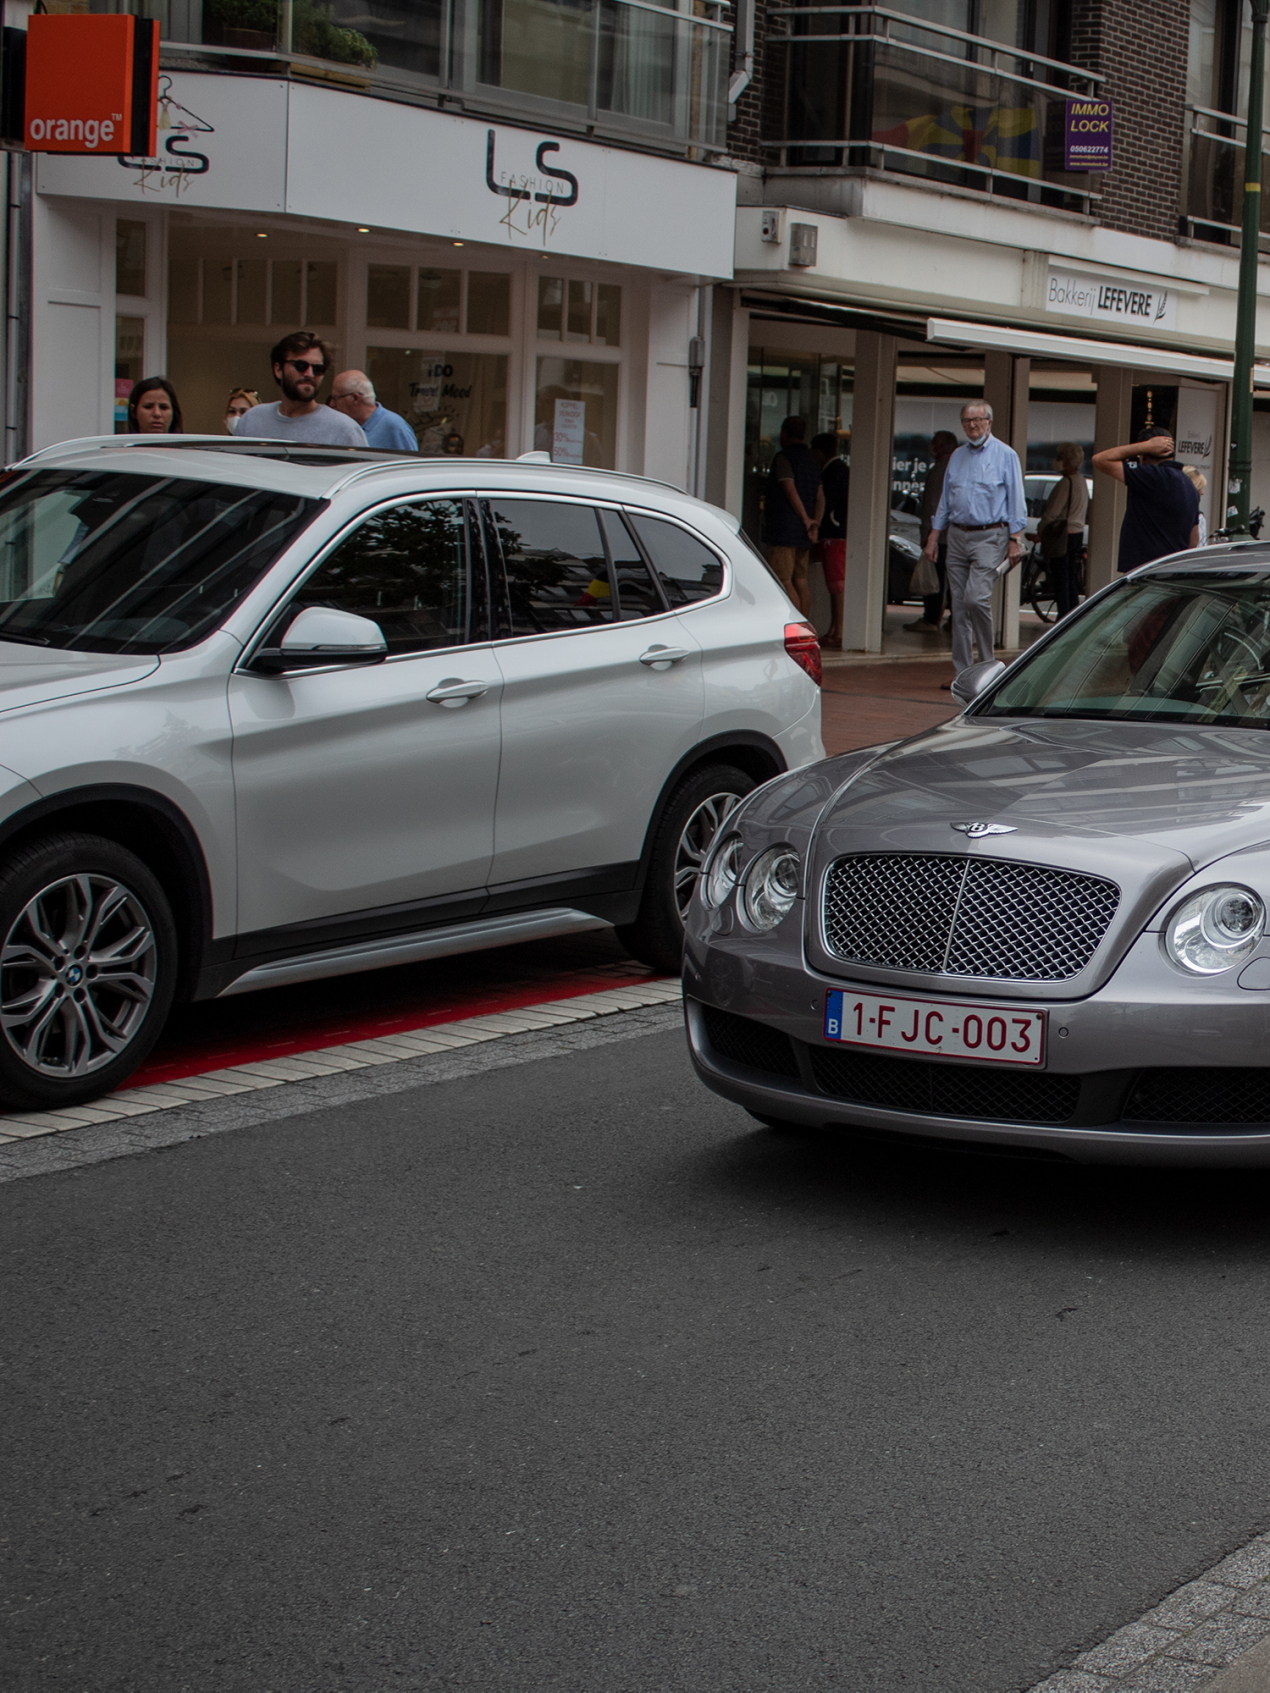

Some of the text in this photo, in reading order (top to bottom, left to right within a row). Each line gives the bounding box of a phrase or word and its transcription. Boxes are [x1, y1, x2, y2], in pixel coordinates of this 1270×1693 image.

[1071, 103, 1109, 116] IMMO
[30, 118, 115, 148] orange
[1070, 120, 1109, 132] LOCK
[1070, 145, 1109, 153] 050622774
[133, 159, 195, 198] Kids
[501, 171, 564, 194] FASHION
[499, 179, 561, 247] Kids
[1049, 278, 1152, 317] Bakkerij LEFEVERE
[1178, 440, 1205, 455] LEFEVERE
[828, 1018, 839, 1034] B
[853, 1002, 1032, 1053] 1-FJC-003
